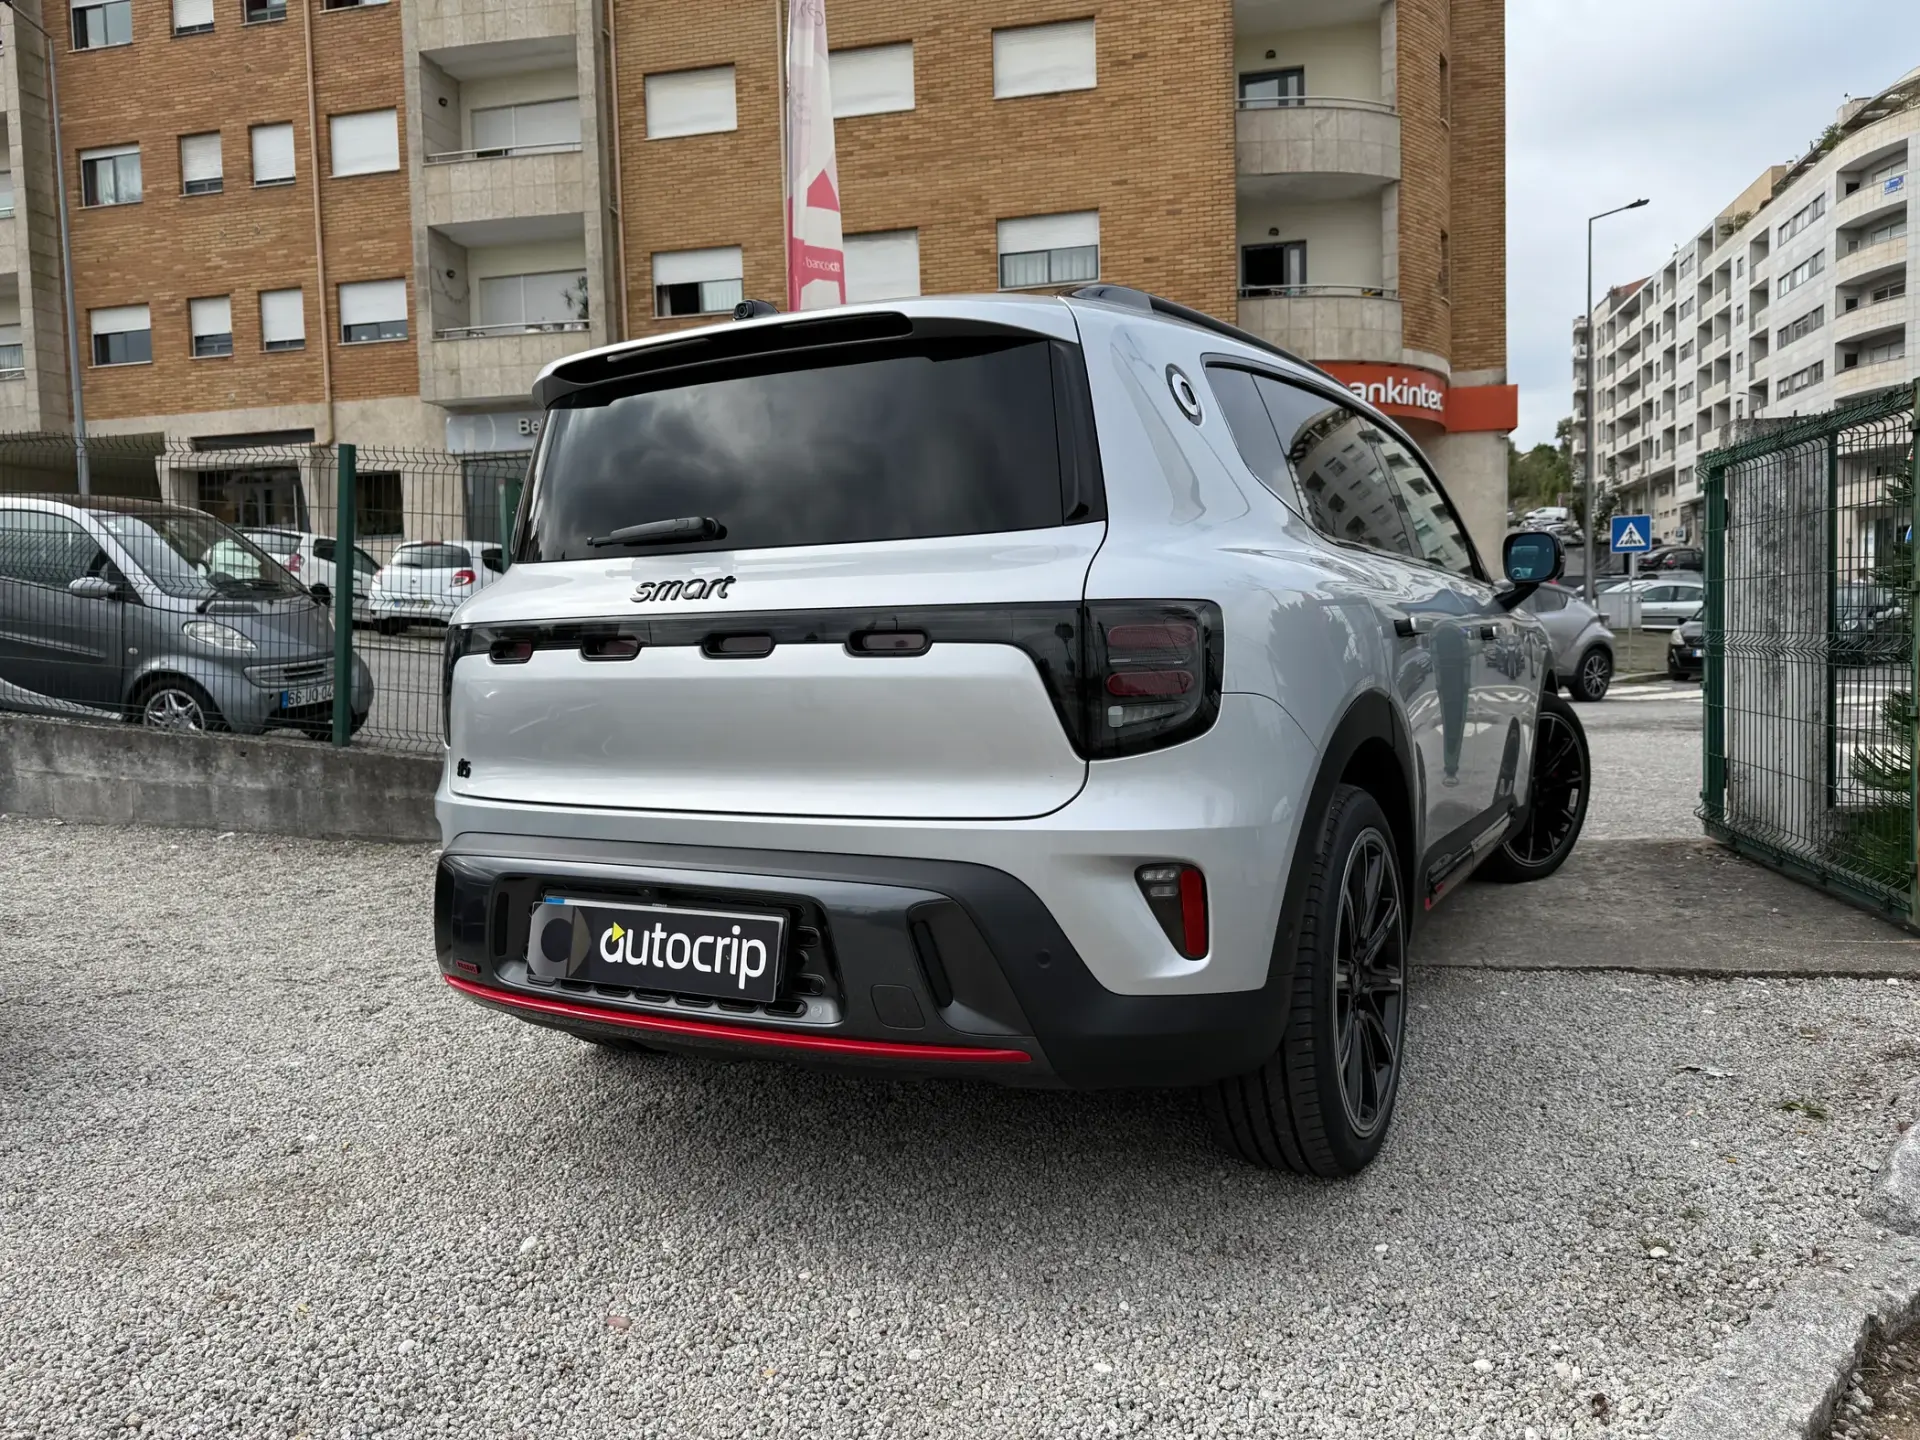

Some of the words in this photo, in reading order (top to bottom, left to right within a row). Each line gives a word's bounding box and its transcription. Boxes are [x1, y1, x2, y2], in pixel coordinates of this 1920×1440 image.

[518, 418, 540, 435] Be
[630, 575, 737, 603] smart
[599, 922, 767, 990] autocrip
